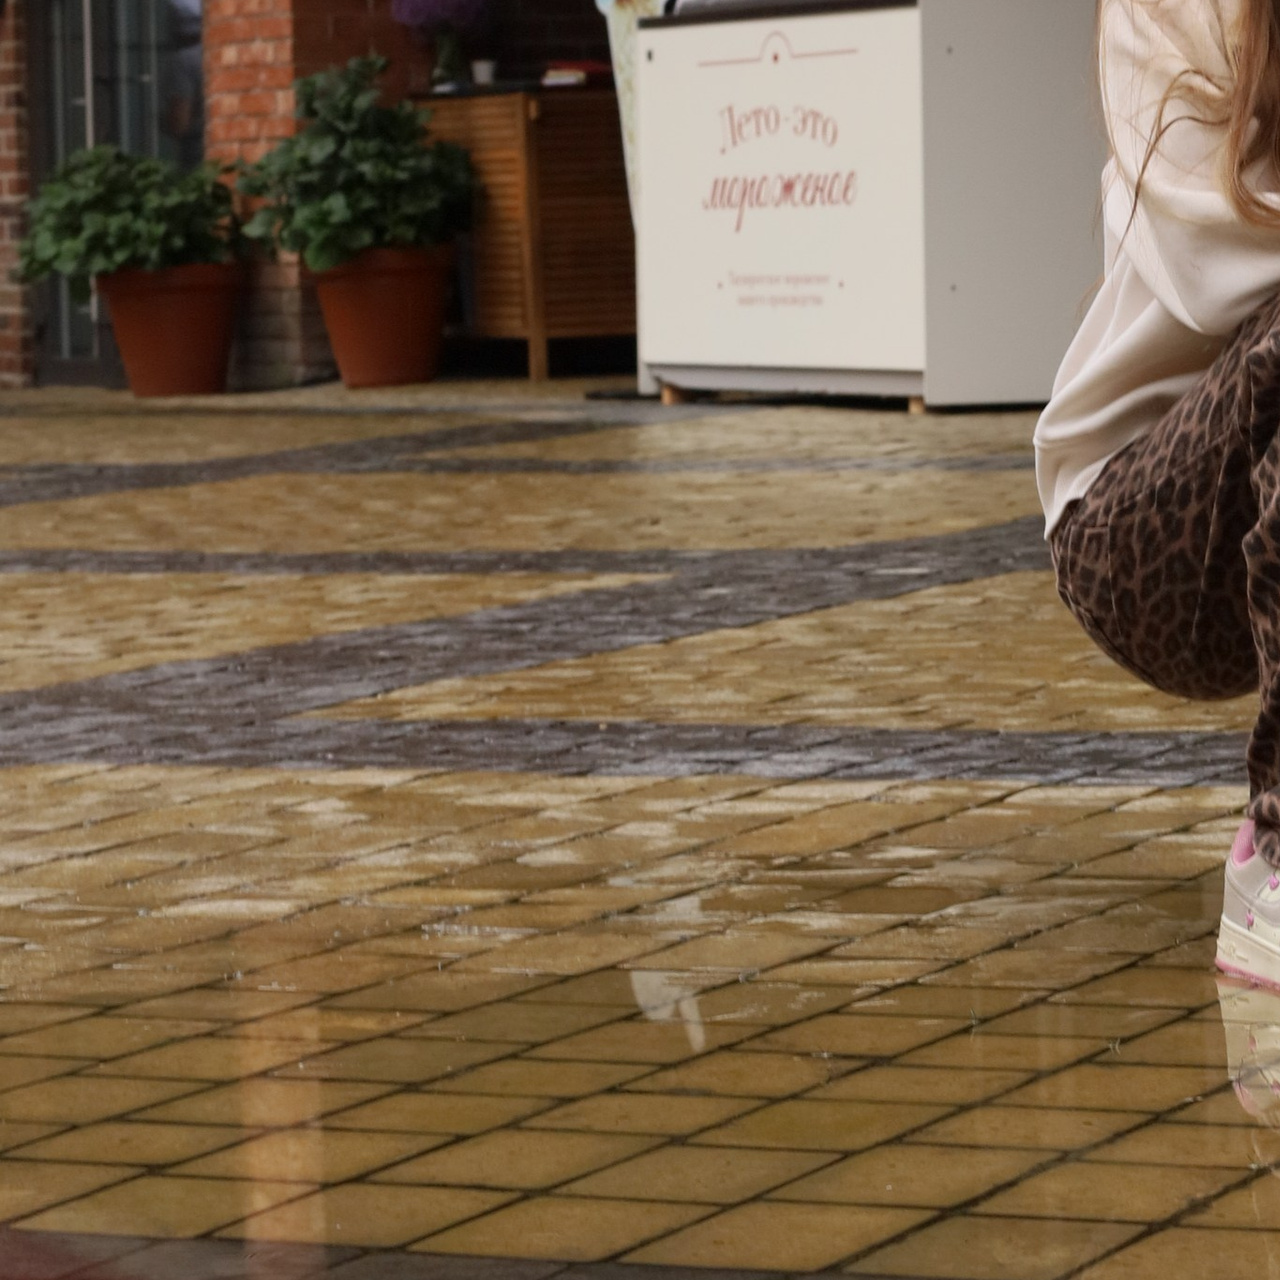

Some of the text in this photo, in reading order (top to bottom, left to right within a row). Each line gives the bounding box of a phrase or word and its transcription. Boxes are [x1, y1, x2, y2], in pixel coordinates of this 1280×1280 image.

[719, 103, 780, 155] Лето
[792, 104, 839, 148] это
[702, 169, 858, 233] мороженое
